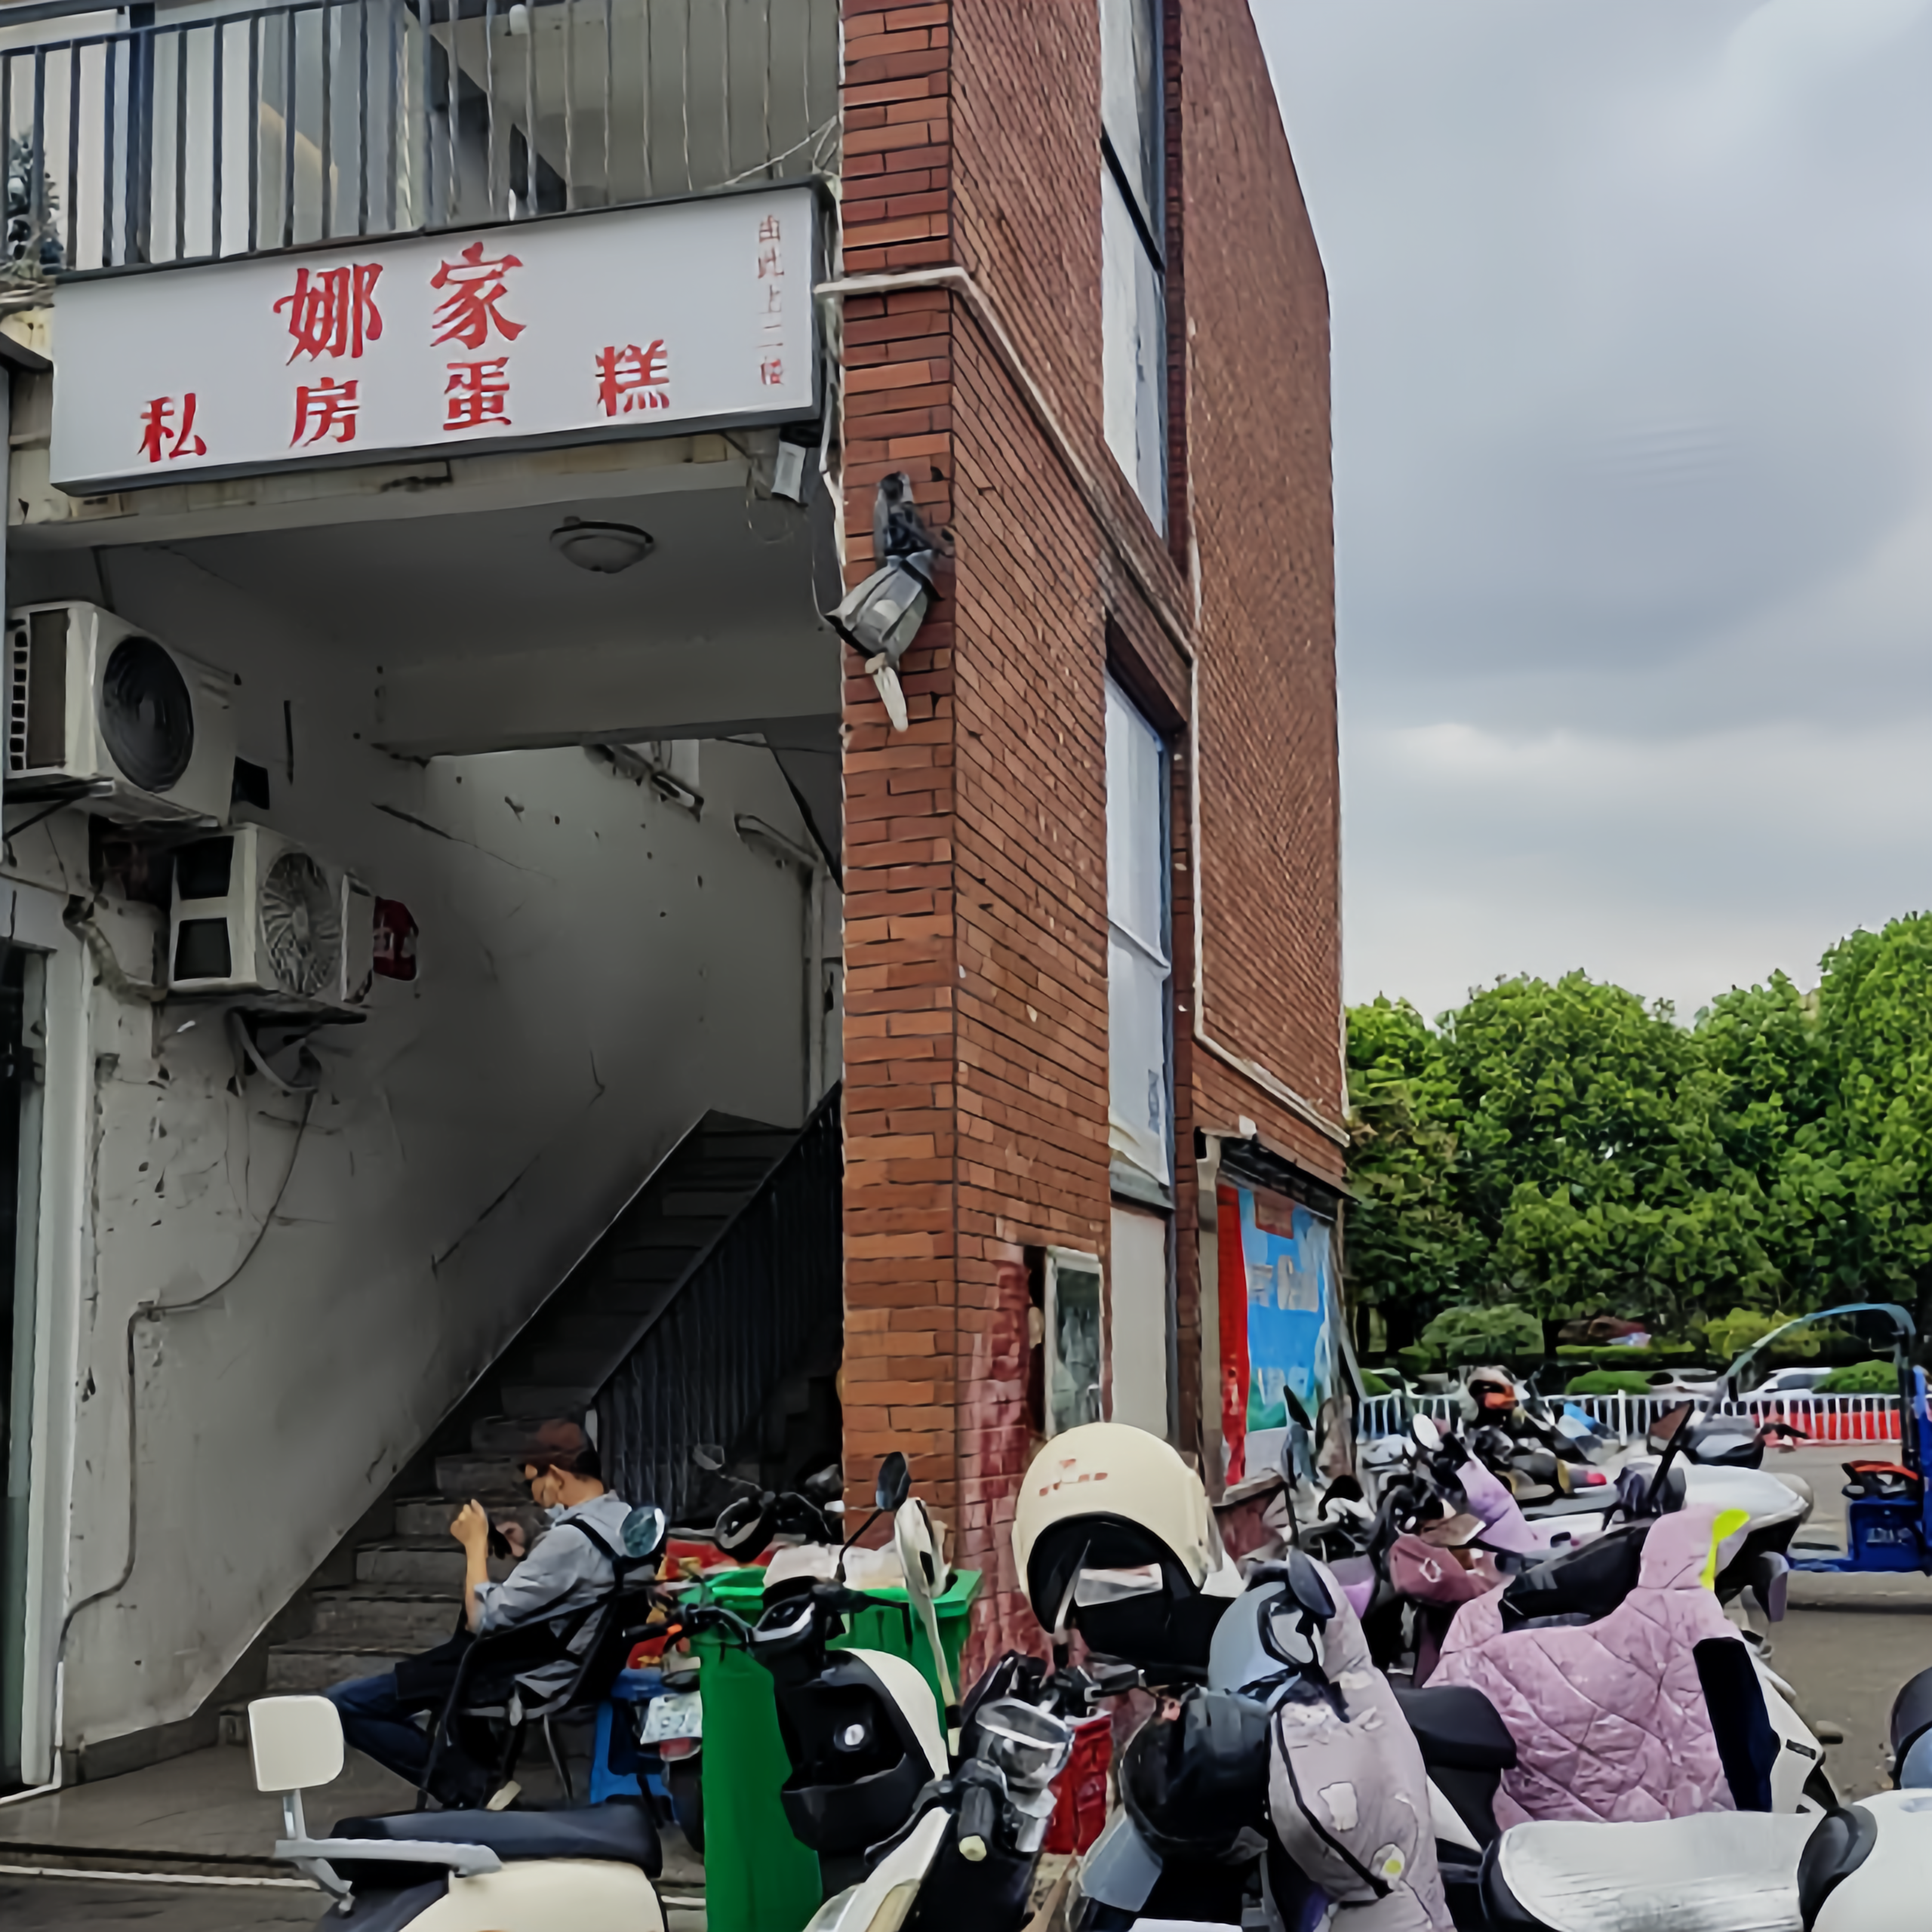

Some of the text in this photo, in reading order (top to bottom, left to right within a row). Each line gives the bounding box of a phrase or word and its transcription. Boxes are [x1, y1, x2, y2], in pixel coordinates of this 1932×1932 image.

[273, 242, 526, 366] 娜家
[139, 340, 671, 463] 私房蛋糕
